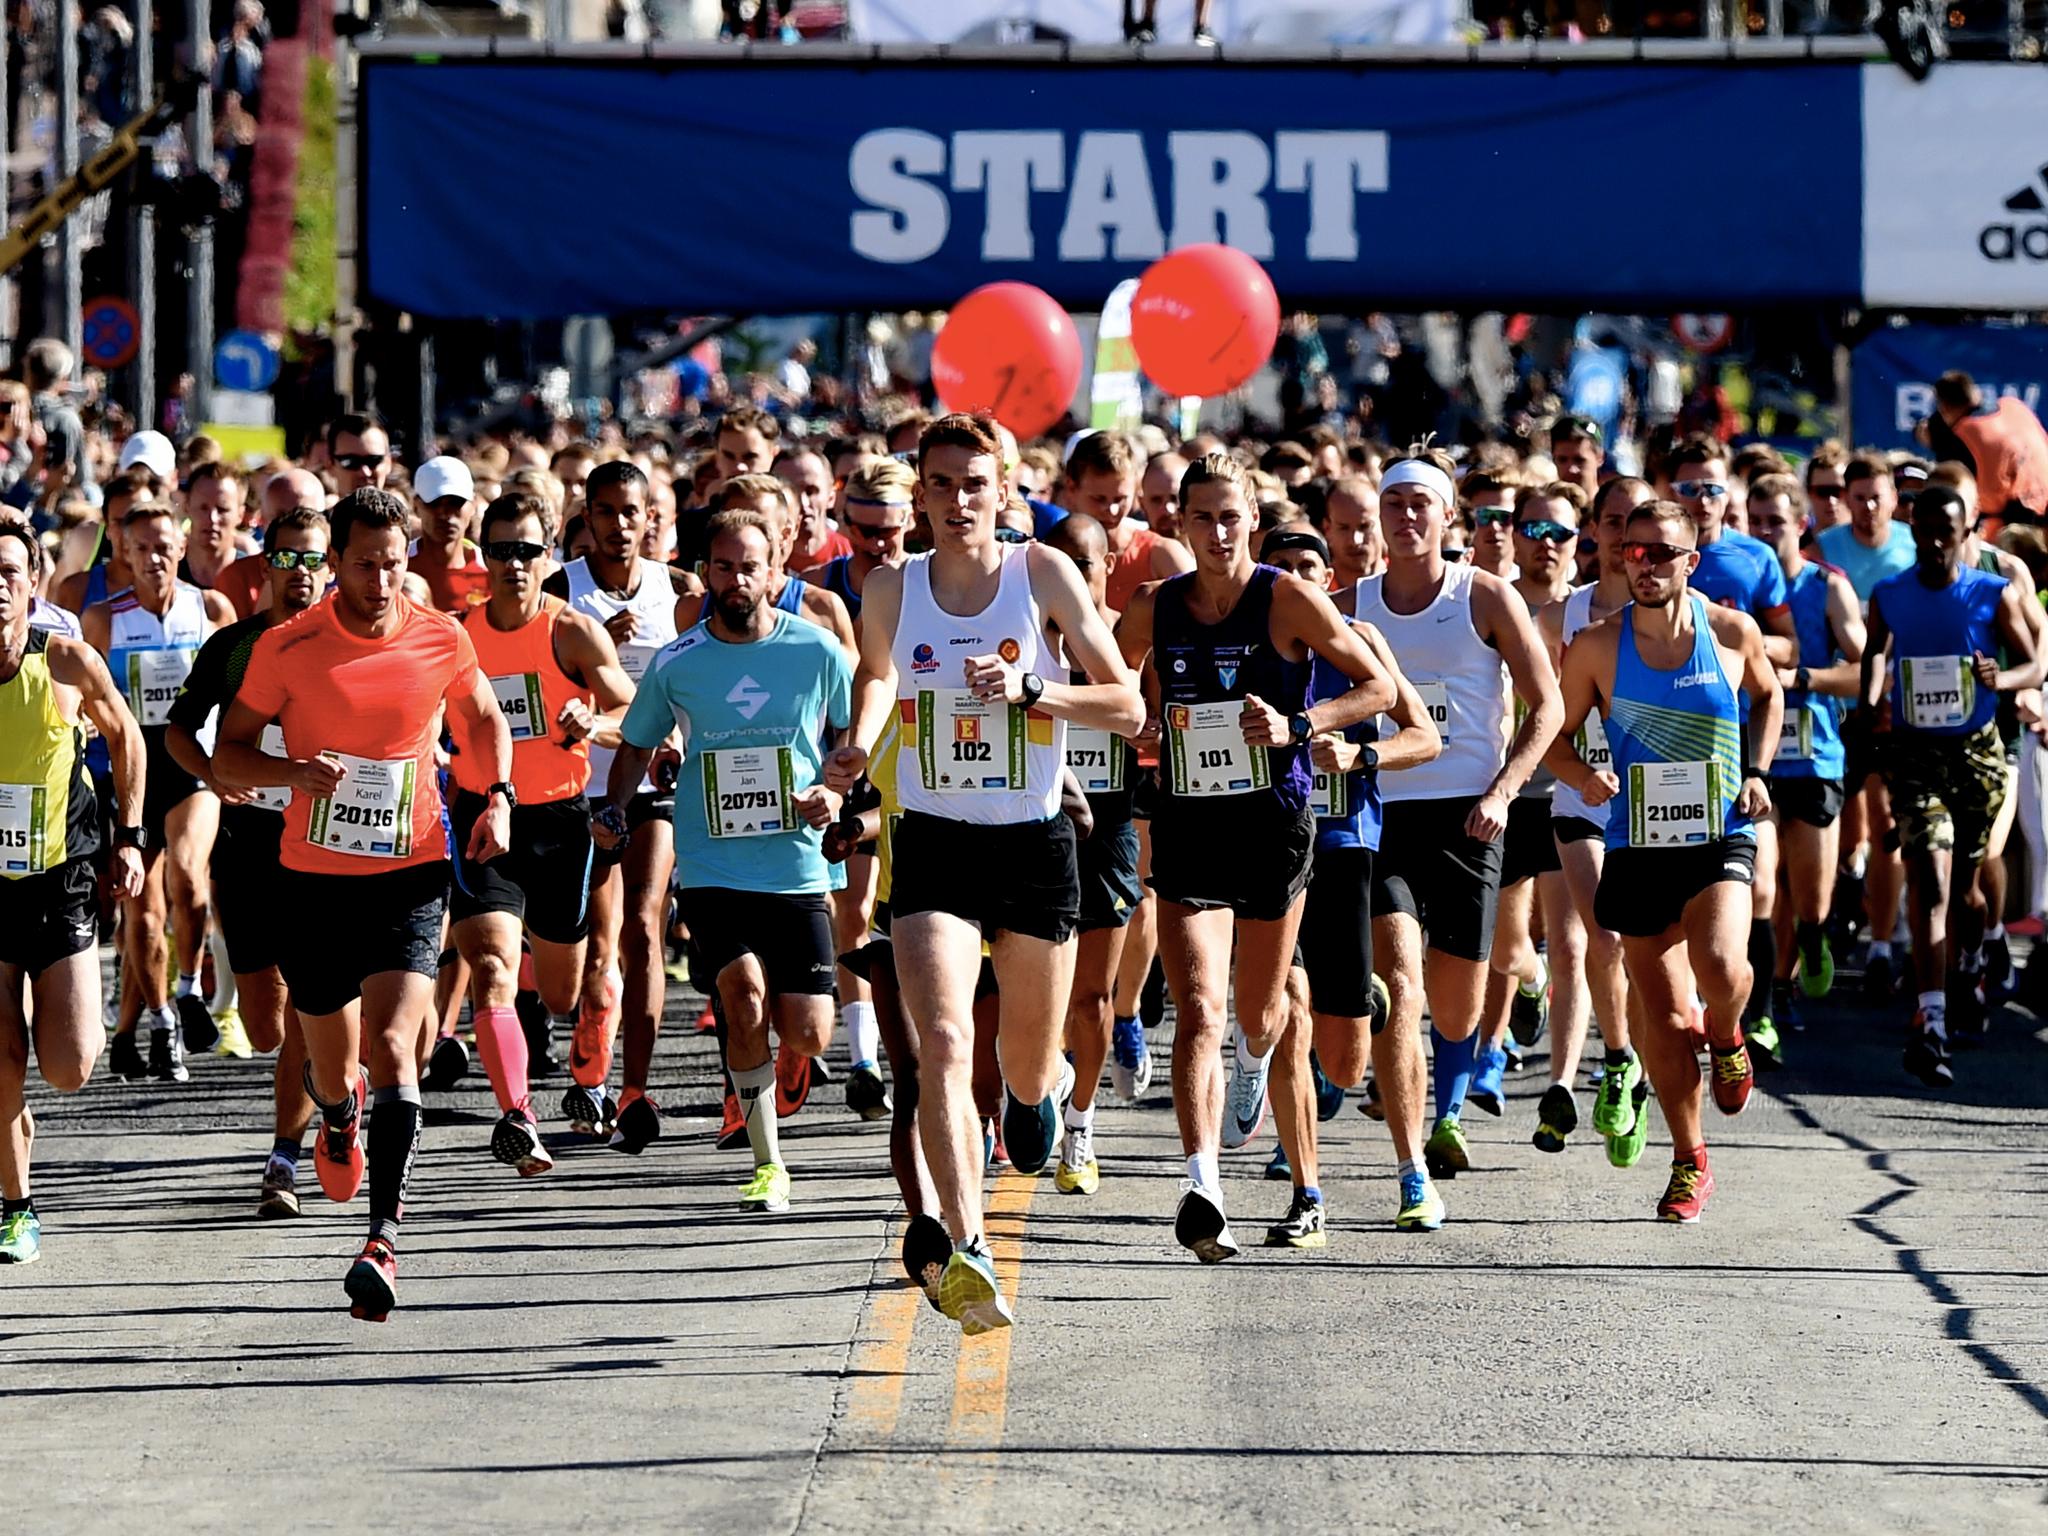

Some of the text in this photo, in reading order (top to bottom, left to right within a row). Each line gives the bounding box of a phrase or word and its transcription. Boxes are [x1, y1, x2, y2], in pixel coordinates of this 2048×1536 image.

[849, 127, 1388, 263] START
[952, 741, 992, 761] 102
[1199, 749, 1233, 768] 101
[740, 776, 756, 786] Jan
[355, 788, 382, 800] Karel
[721, 790, 777, 811] 20791
[333, 803, 393, 827] 20116
[1648, 804, 1704, 821] 21006
